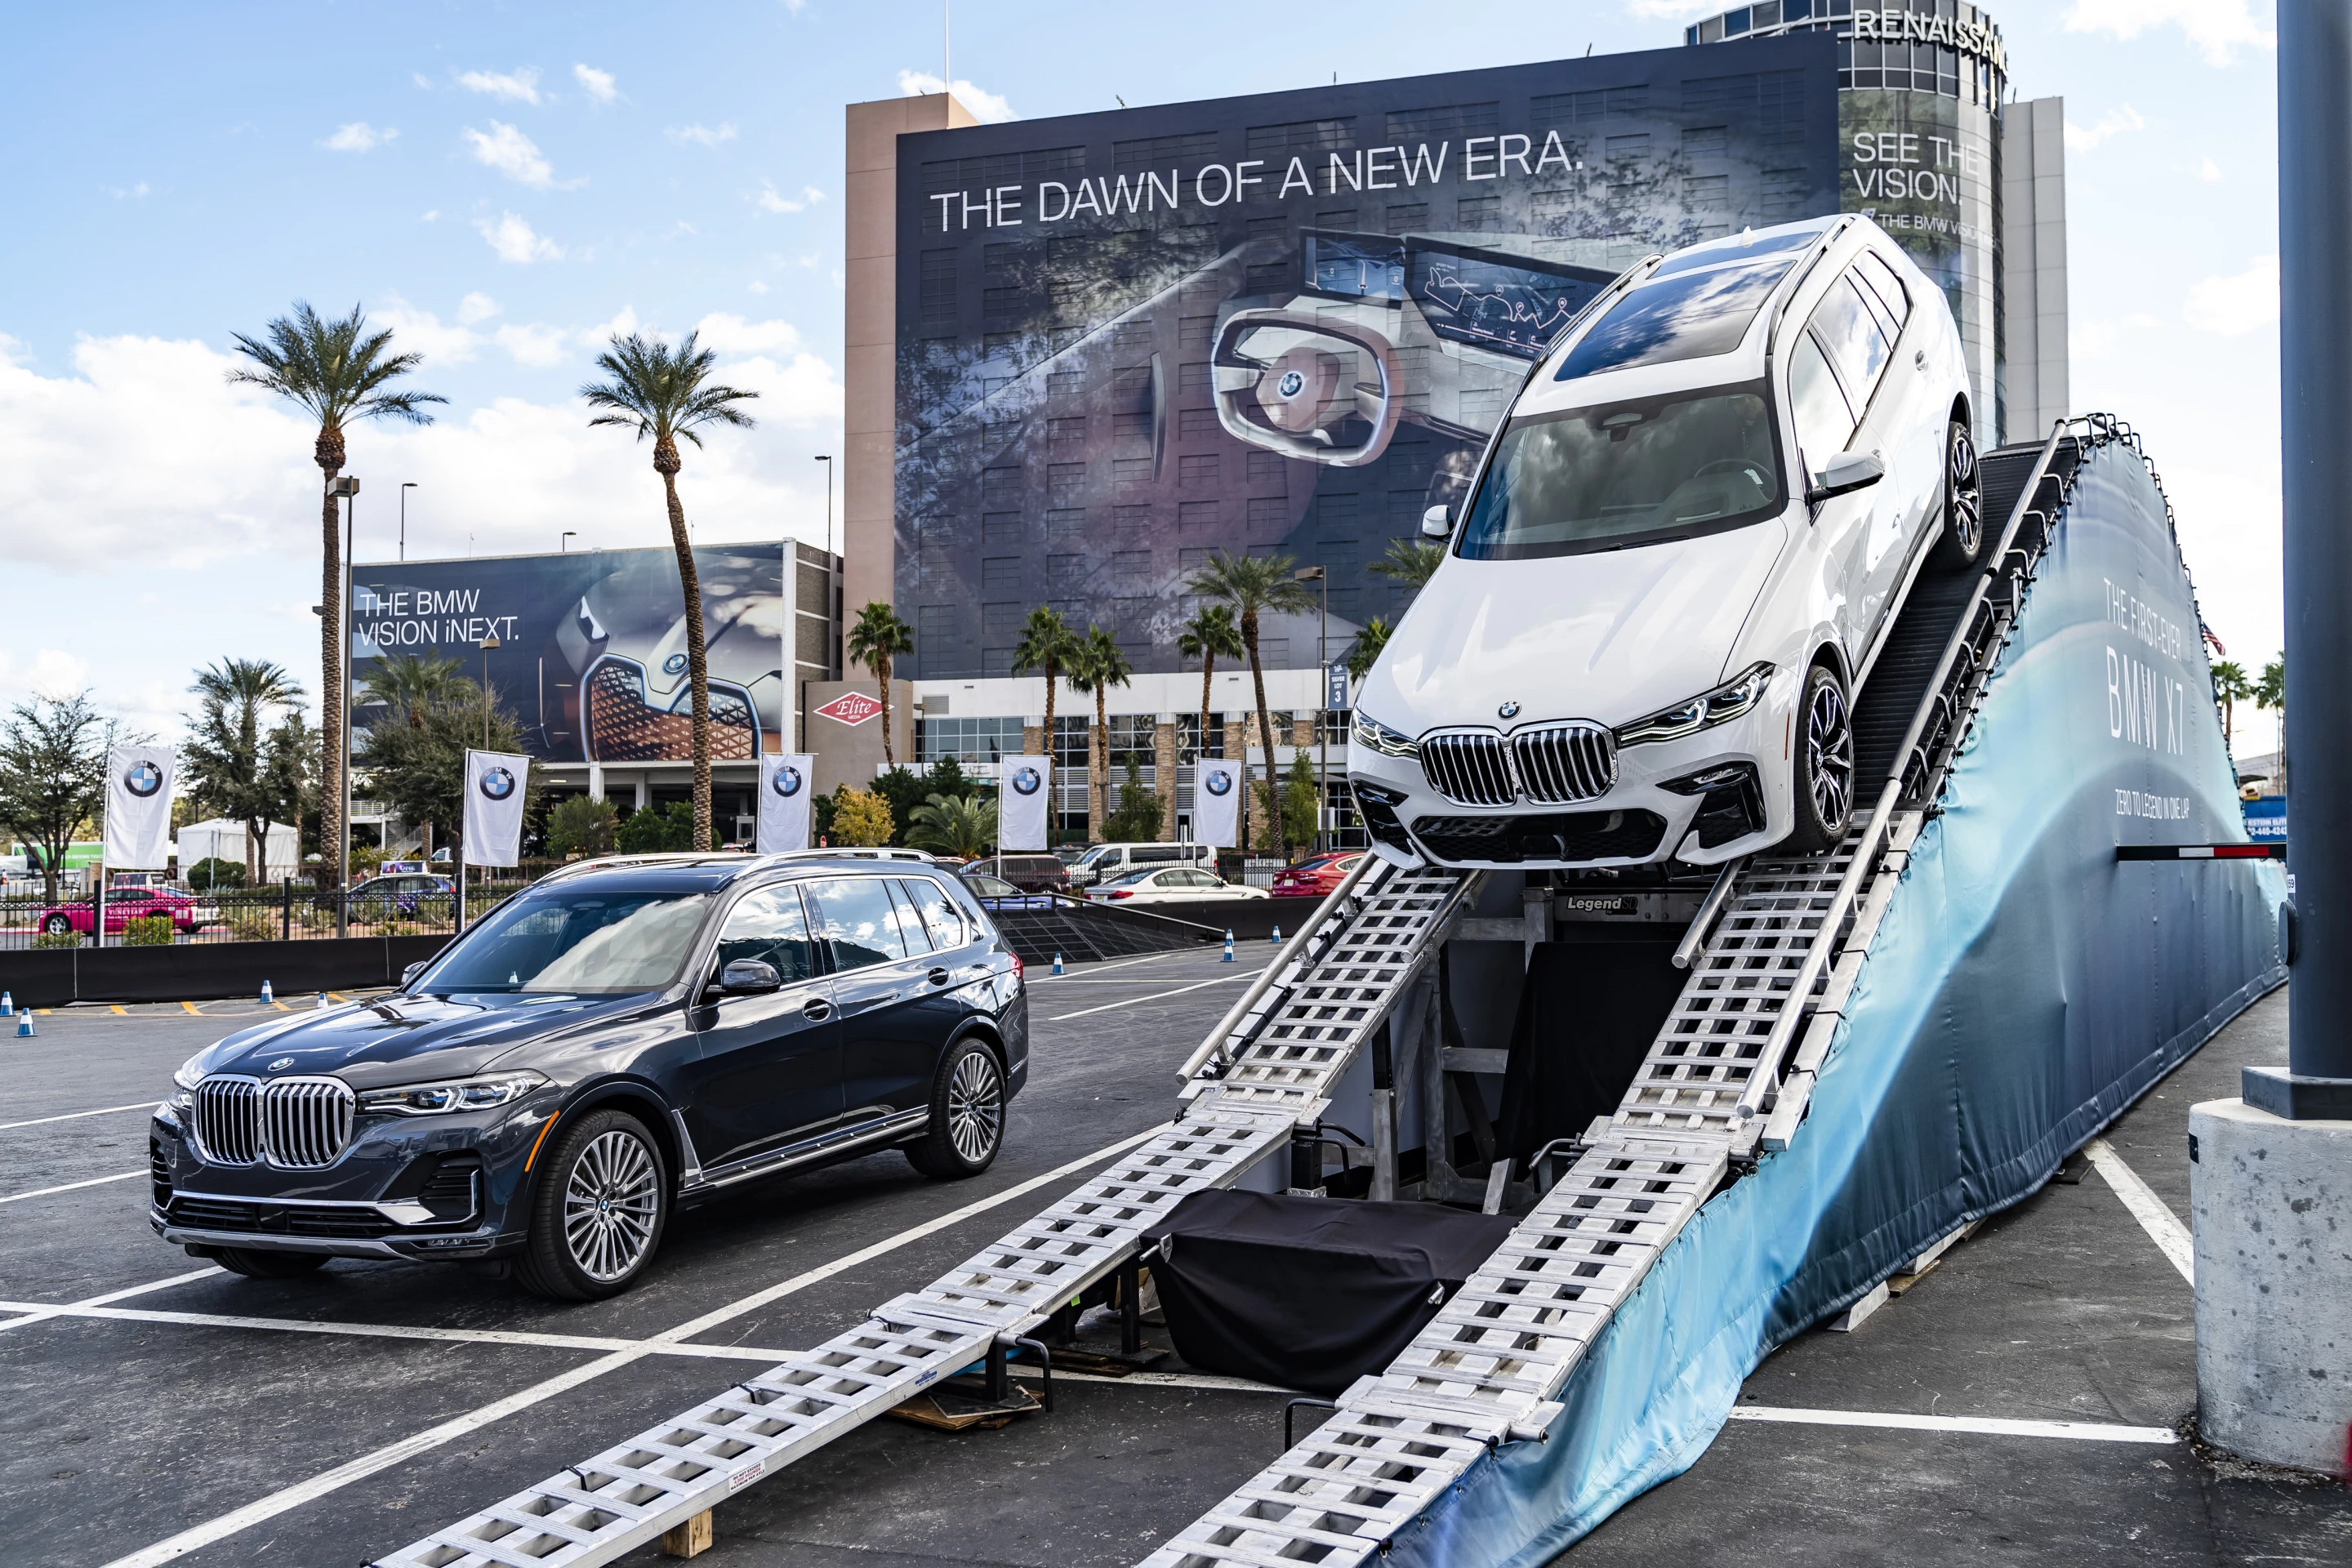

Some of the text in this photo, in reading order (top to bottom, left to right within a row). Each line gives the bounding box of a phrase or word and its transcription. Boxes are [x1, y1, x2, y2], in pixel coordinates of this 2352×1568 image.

[1854, 9, 2008, 76] RENAISSANC
[1853, 131, 1979, 176] SEE THE
[929, 130, 1584, 232] THE DAWN OF A NEW ERA.
[1852, 167, 1962, 206] VISION.
[1878, 213, 1910, 229] THE
[1913, 216, 1948, 234] BMW
[359, 589, 480, 617] THE BMW
[359, 616, 519, 646] VISION iNEXT.
[2104, 577, 2182, 662] THE FIRST-EVER
[835, 696, 872, 715] Elite
[1334, 690, 1342, 702] 3
[2106, 645, 2183, 755] BMW X7
[2115, 788, 2189, 820] ZERO TO LEGEND IN ONE LAP
[745, 1467, 760, 1477] POUNDS
[747, 1463, 760, 1472] EXCEED
[731, 1479, 747, 1490] MAXIMUM
